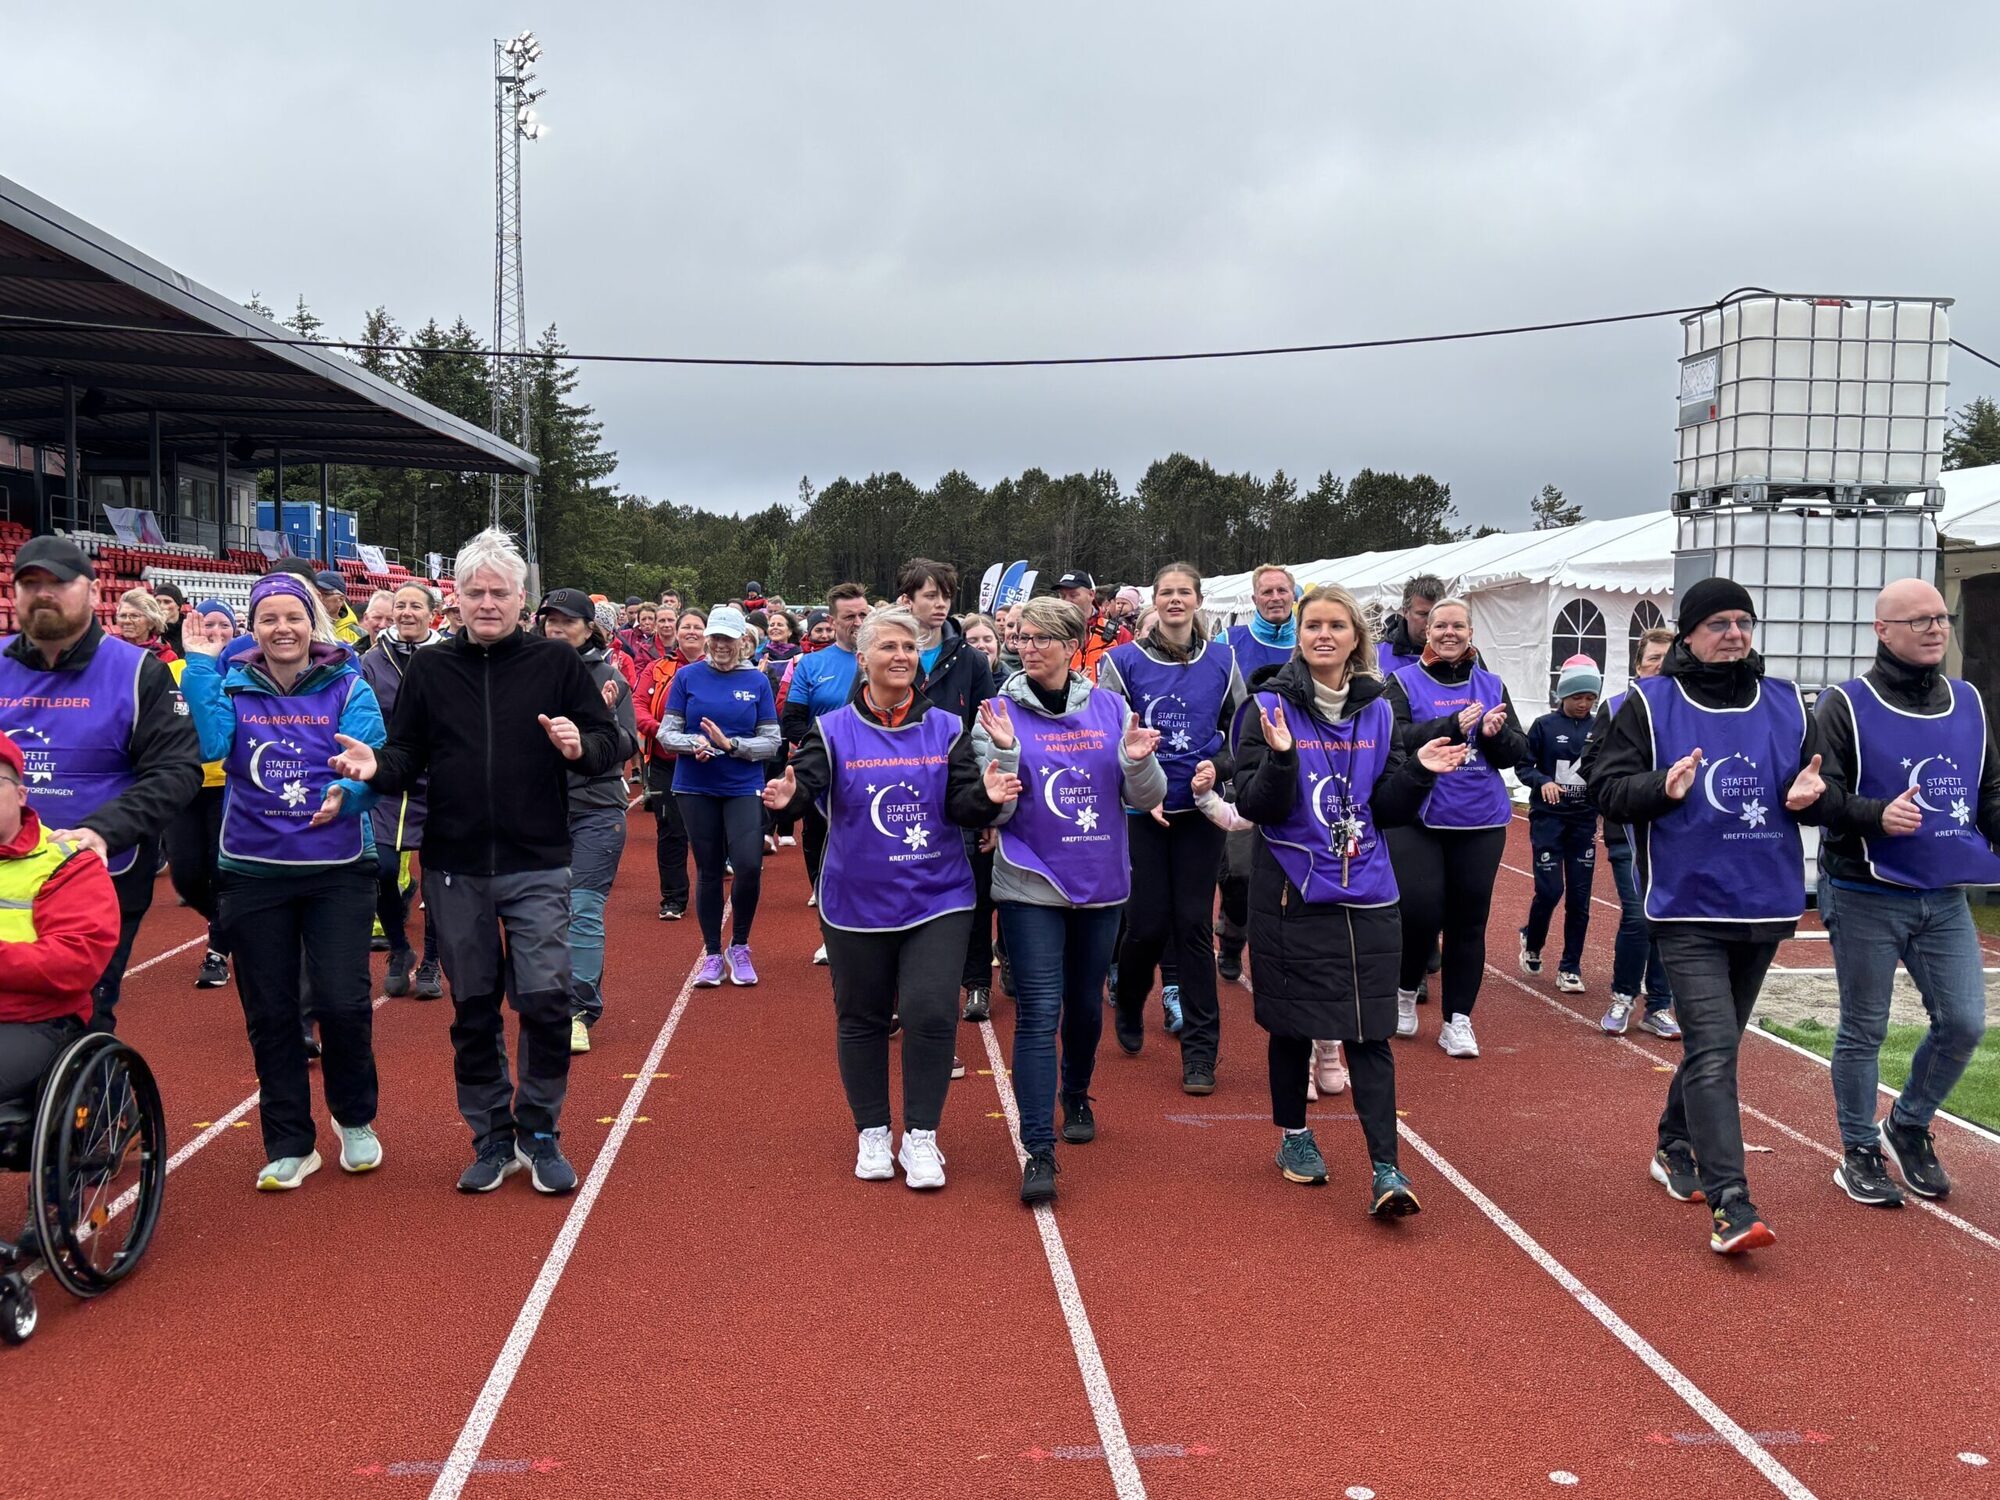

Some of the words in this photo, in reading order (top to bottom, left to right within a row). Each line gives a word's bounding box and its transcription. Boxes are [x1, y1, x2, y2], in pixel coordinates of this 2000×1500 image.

[1157, 711, 1187, 720] STAFETT
[1157, 720, 1171, 728] FOR
[1045, 741, 1104, 752] ANSVARLIG
[22, 751, 50, 760] FETT
[28, 762, 56, 771] LIVET
[265, 760, 302, 769] STAFETT
[265, 770, 283, 778] FOR
[284, 770, 309, 778] LIVET
[1721, 776, 1758, 787] STAFETT
[1926, 777, 1962, 787] STAFETT
[1059, 786, 1092, 795] STAFETT
[1722, 787, 1740, 797] FOR
[1742, 787, 1765, 796] LIVET
[1928, 787, 1947, 796] FOR
[1060, 796, 1076, 804] FOR
[1077, 795, 1098, 804] LIVET
[886, 804, 921, 813] STAFETT
[887, 814, 904, 822] FOR
[905, 812, 928, 821] LIVET
[1061, 833, 1111, 843] KREFTFORENINGEN
[1722, 831, 1784, 841] KREFTFORENINGEN
[888, 850, 942, 862] KREFTFORENINGEN
